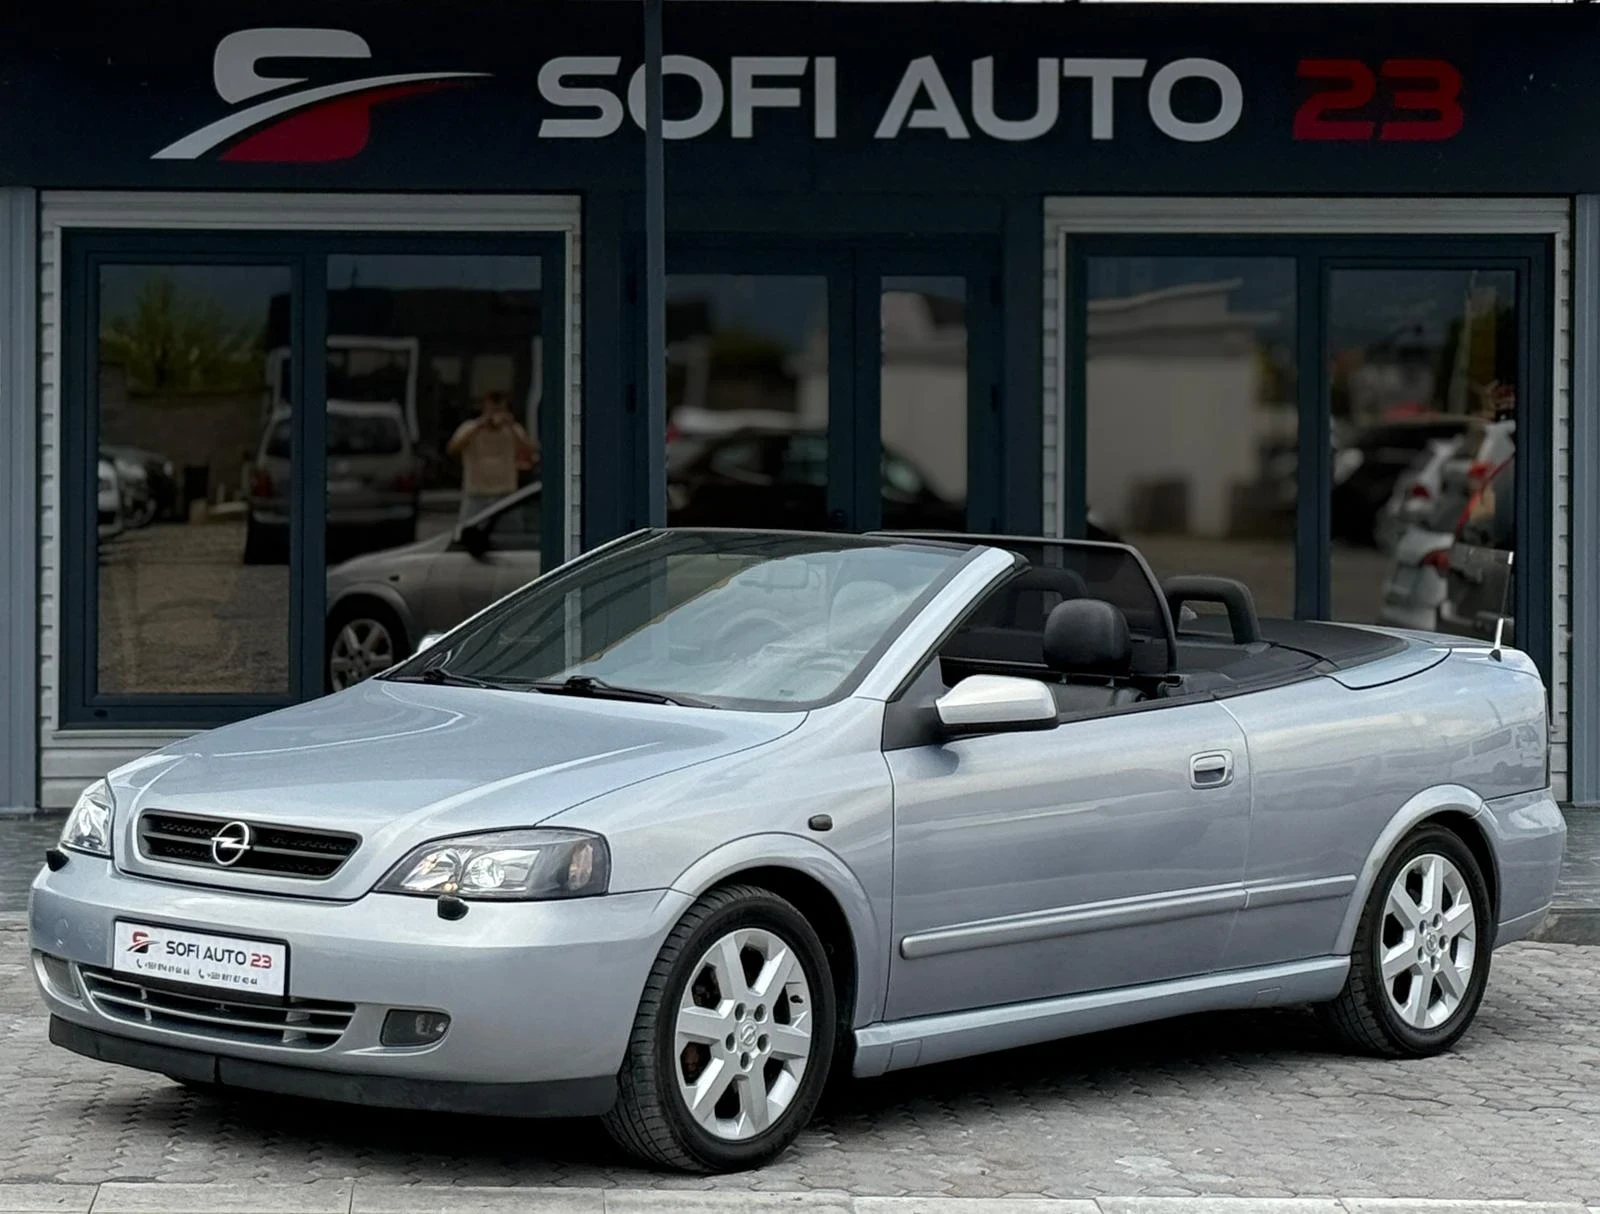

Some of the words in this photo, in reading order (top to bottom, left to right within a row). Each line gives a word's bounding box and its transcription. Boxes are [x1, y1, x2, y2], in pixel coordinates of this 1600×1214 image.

[537, 55, 836, 139] SOFI
[875, 56, 1242, 141] AUTO
[1293, 59, 1464, 141] 23
[166, 940, 200, 959] SOFI
[203, 945, 247, 966] AUTO
[250, 953, 272, 969] 23
